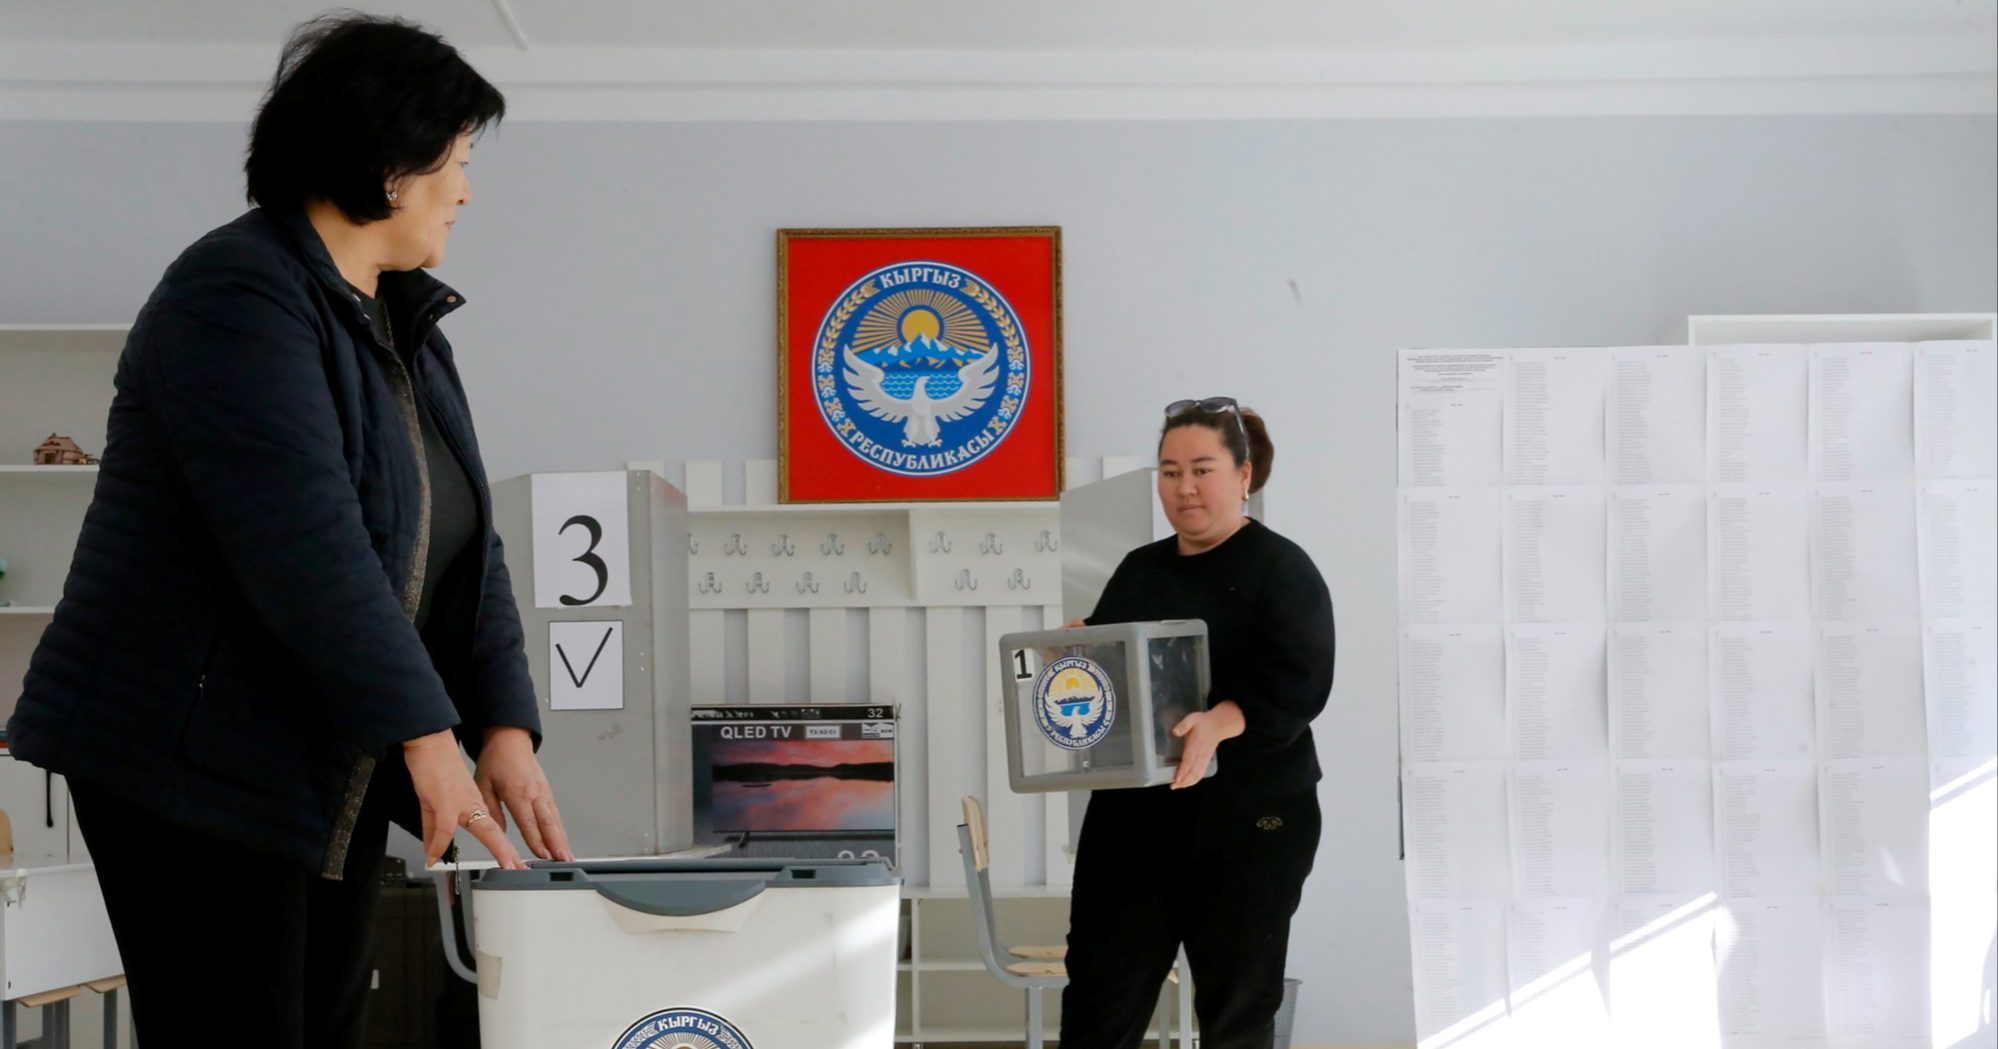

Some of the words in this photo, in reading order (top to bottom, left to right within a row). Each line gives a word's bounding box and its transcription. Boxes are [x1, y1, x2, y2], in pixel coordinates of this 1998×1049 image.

[879, 267, 961, 289] КЫРГЫЗ
[849, 429, 995, 470] РЕСПУБЛИКАСЫ
[558, 514, 608, 606] 3
[1014, 649, 1032, 679] 1
[867, 708, 883, 718] 32
[720, 726, 767, 739] QLED
[770, 726, 792, 738] TV
[656, 1015, 719, 1036] КЫРГЫЗ
